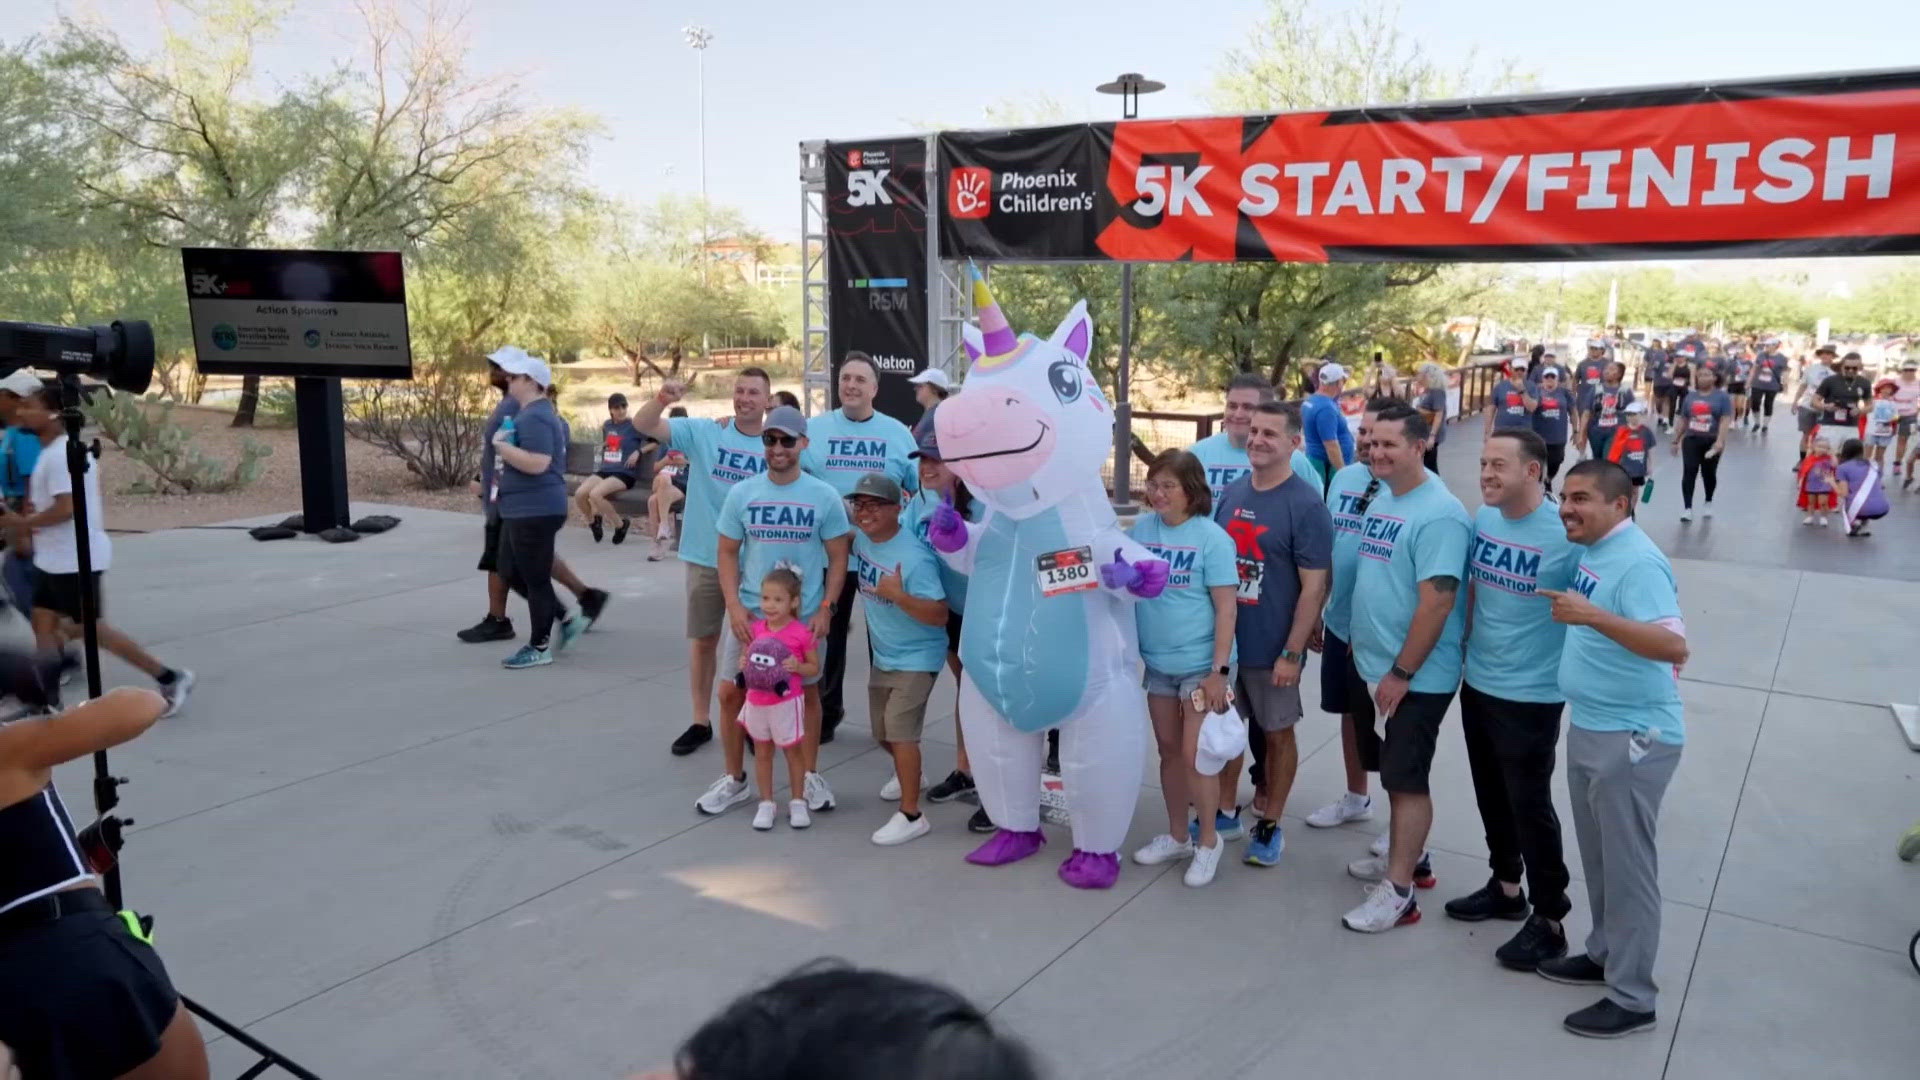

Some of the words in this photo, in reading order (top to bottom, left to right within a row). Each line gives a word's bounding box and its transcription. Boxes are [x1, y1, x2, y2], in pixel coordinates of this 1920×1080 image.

[847, 169, 893, 207] 5K
[1001, 169, 1077, 190] Phoenix
[1134, 165, 1215, 217] 5K
[1237, 133, 1897, 224] START/FINISH
[1000, 192, 1093, 213] Children's
[256, 304, 288, 314] Action
[291, 305, 338, 316] Sponsors
[869, 291, 908, 311] RSM
[828, 439, 887, 457] TEAM
[825, 459, 886, 469] AUTONATION
[1208, 468, 1250, 485] TE
[747, 506, 815, 527] TEAM
[1472, 536, 1541, 577] TEAM
[857, 555, 886, 587] TEA
[1047, 564, 1088, 584] 1380
